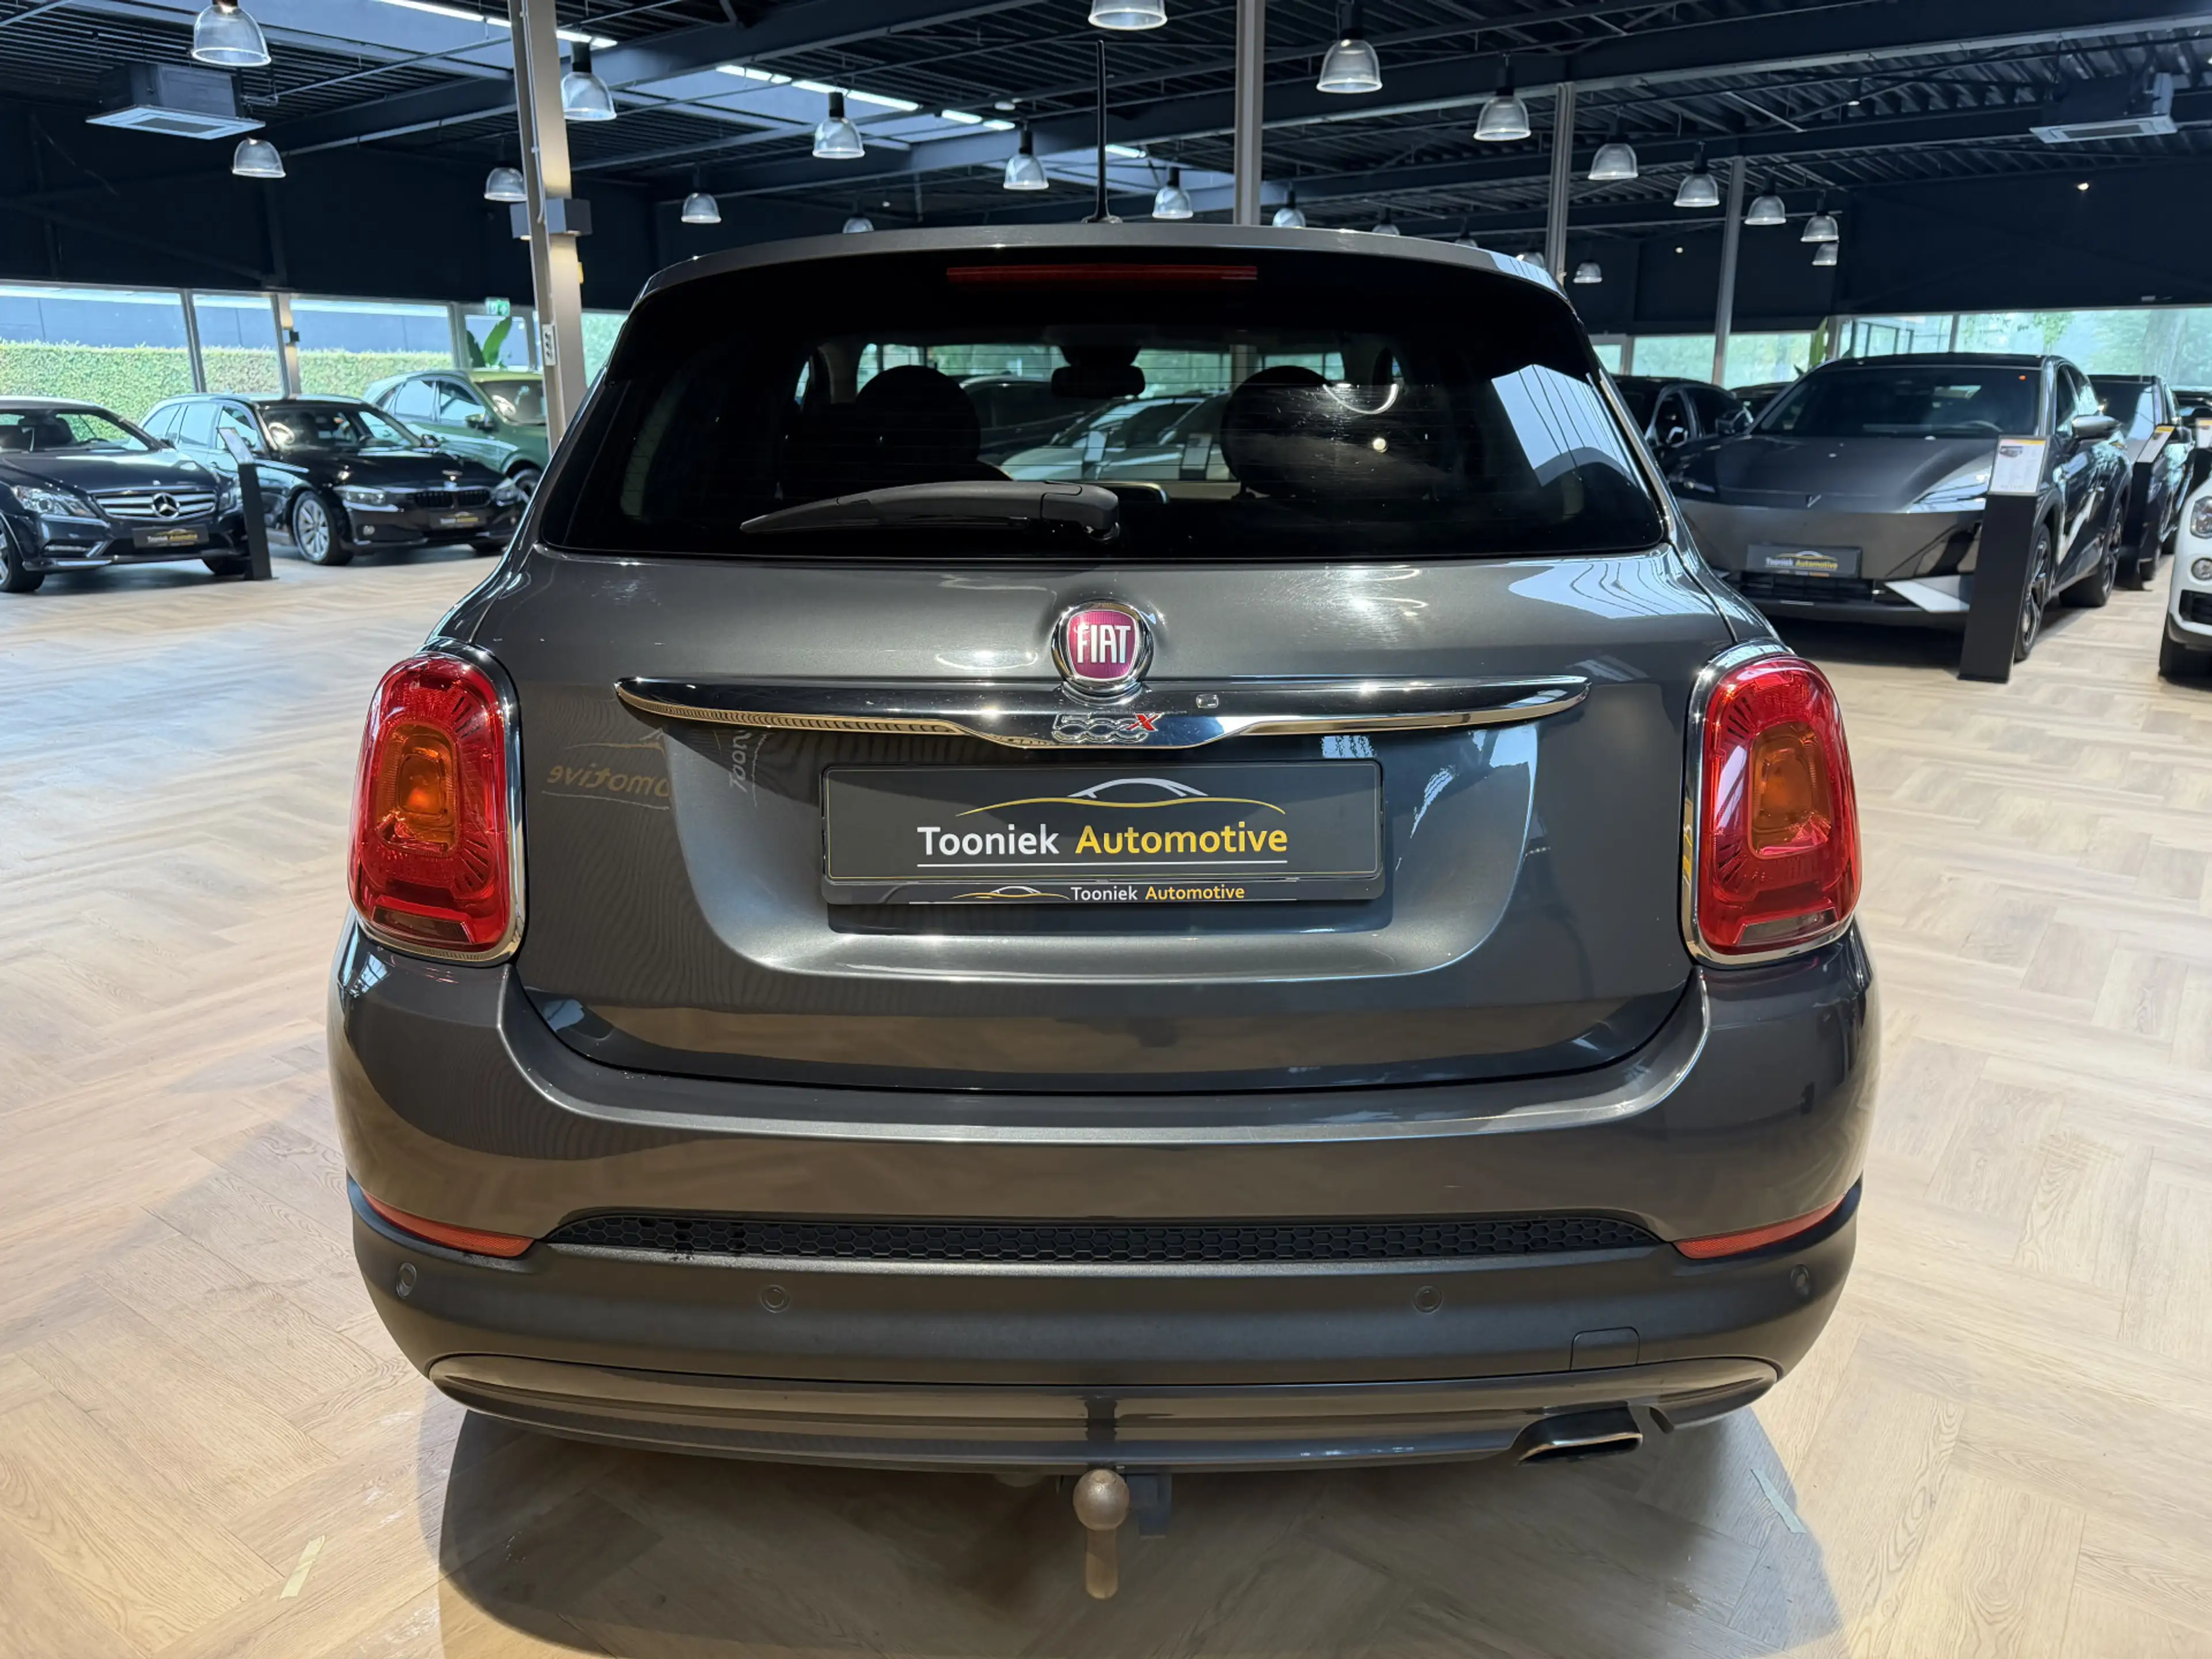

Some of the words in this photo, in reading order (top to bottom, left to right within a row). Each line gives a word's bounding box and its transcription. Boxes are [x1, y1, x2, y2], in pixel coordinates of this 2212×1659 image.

[1076, 625, 1131, 663] FIAT
[917, 824, 1059, 855] Tooniek
[1075, 821, 1287, 854] Automotive
[1071, 886, 1138, 900] Tooniek
[1145, 884, 1245, 900] Automotive
